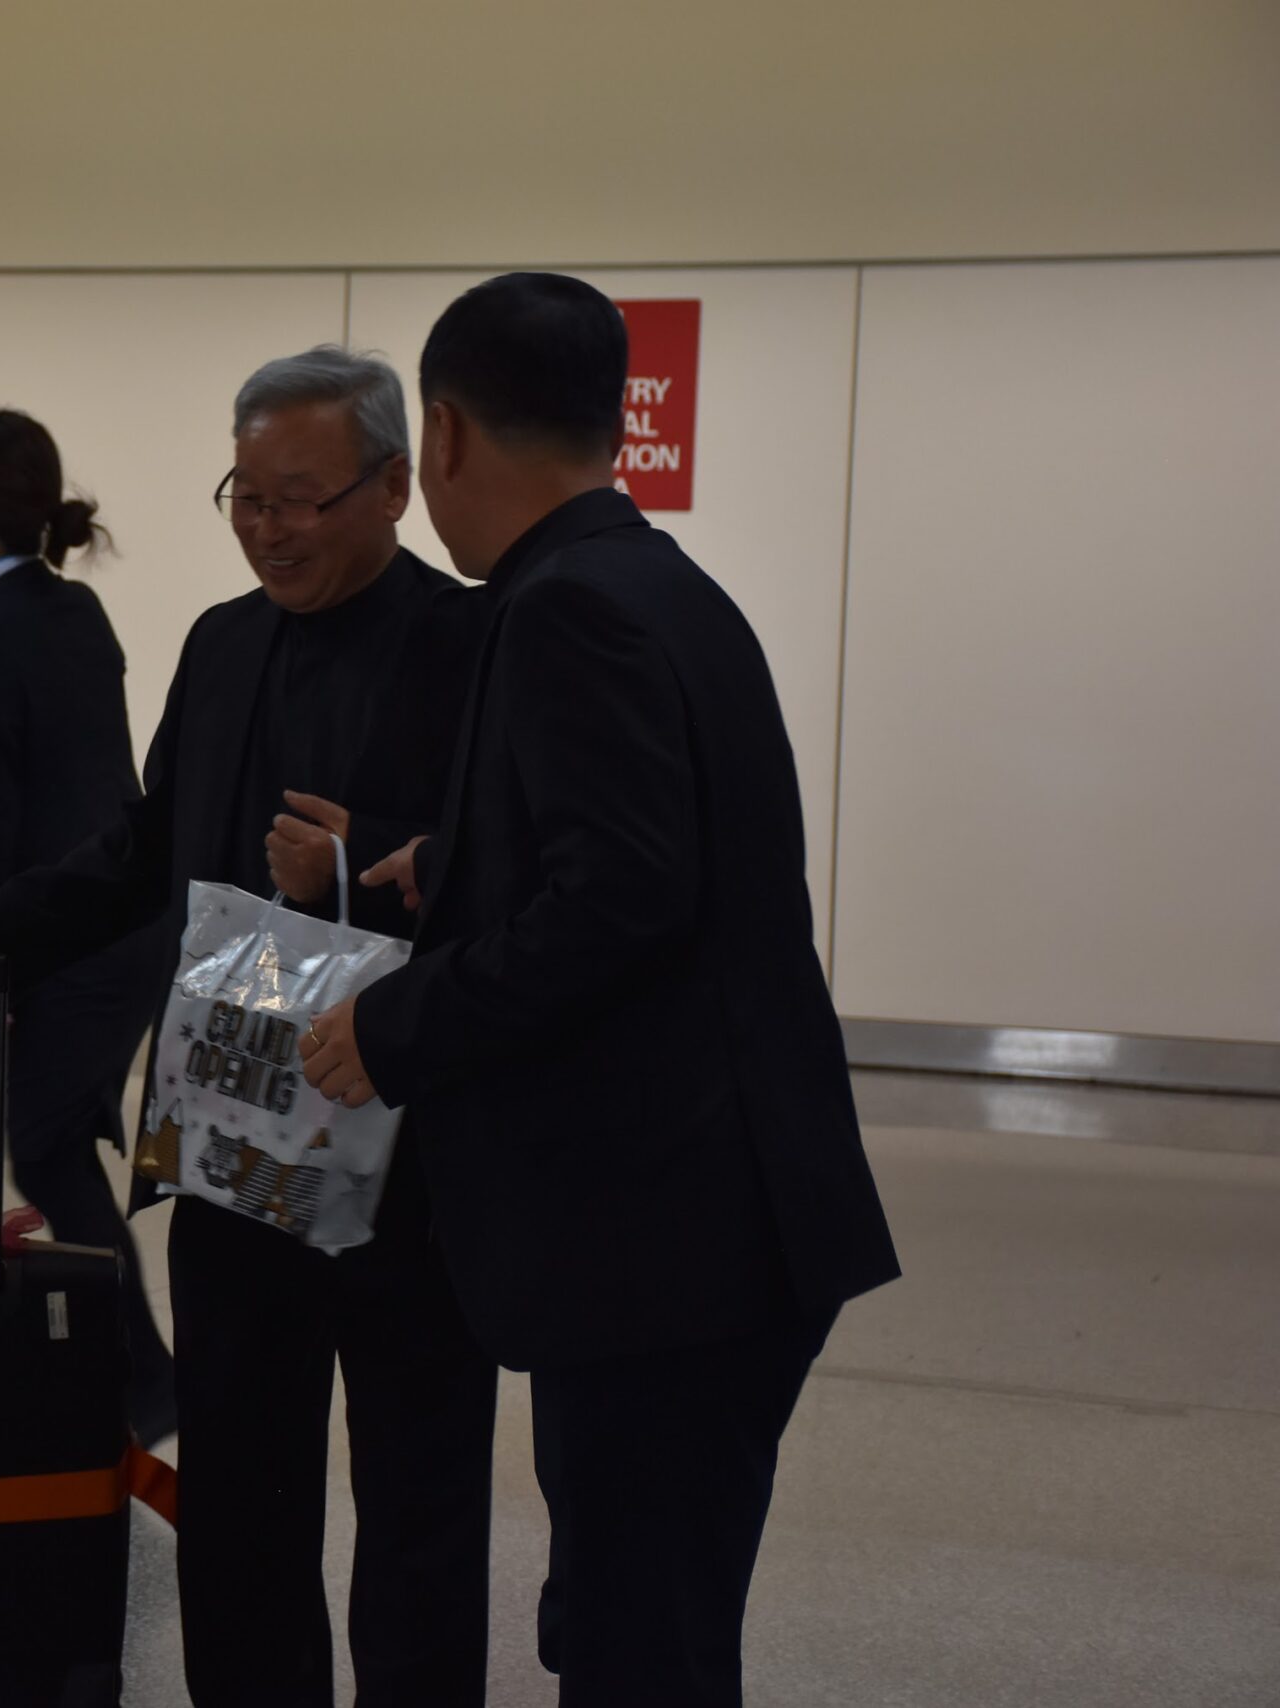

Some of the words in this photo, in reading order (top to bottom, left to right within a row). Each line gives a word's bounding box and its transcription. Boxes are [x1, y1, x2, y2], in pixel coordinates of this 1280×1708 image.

[624, 410, 659, 438] AL
[613, 443, 681, 472] TION
[206, 1000, 297, 1067] GRAND
[185, 1039, 297, 1115] OPENING
